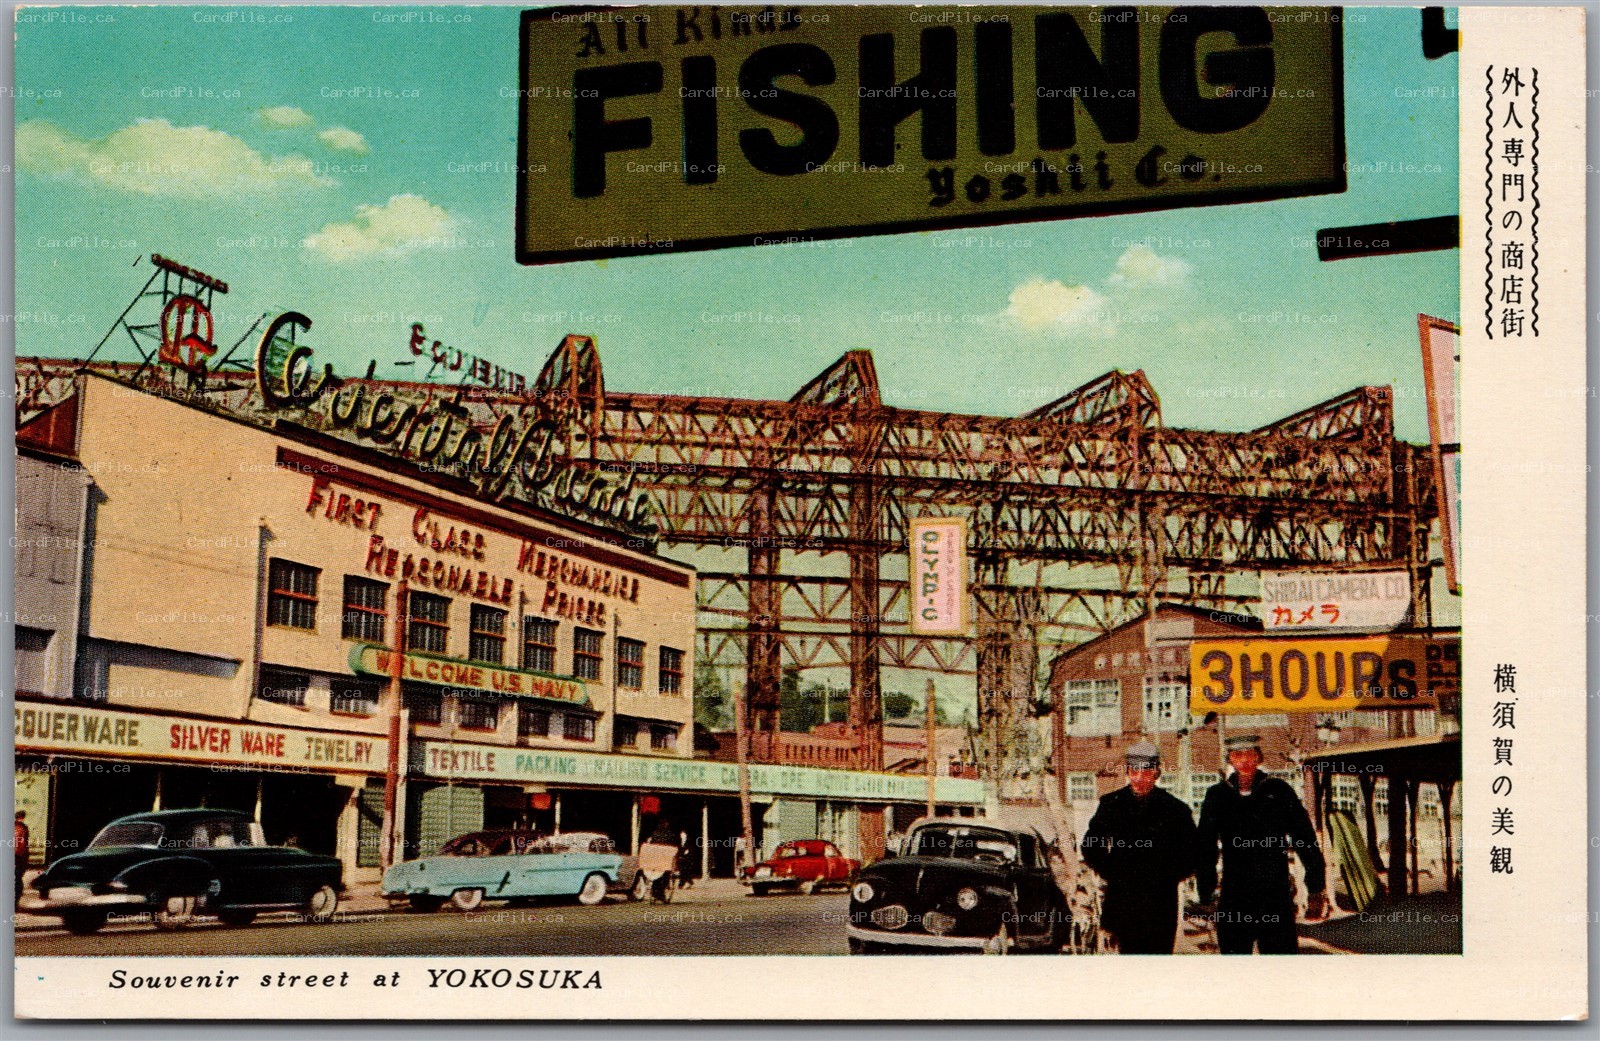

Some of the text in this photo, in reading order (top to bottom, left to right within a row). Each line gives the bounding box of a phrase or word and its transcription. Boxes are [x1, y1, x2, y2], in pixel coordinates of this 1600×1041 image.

[576, 17, 648, 58] All
[572, 5, 1275, 199] FISHING
[305, 476, 385, 532] FIRST
[411, 507, 489, 561] CLASS
[366, 534, 516, 605] REASONABLE
[1271, 603, 1342, 626] カメラ
[376, 650, 486, 688] WLCOME
[531, 677, 579, 702] NAVY
[169, 723, 232, 754] SILVER
[428, 747, 497, 773] TEXTILE
